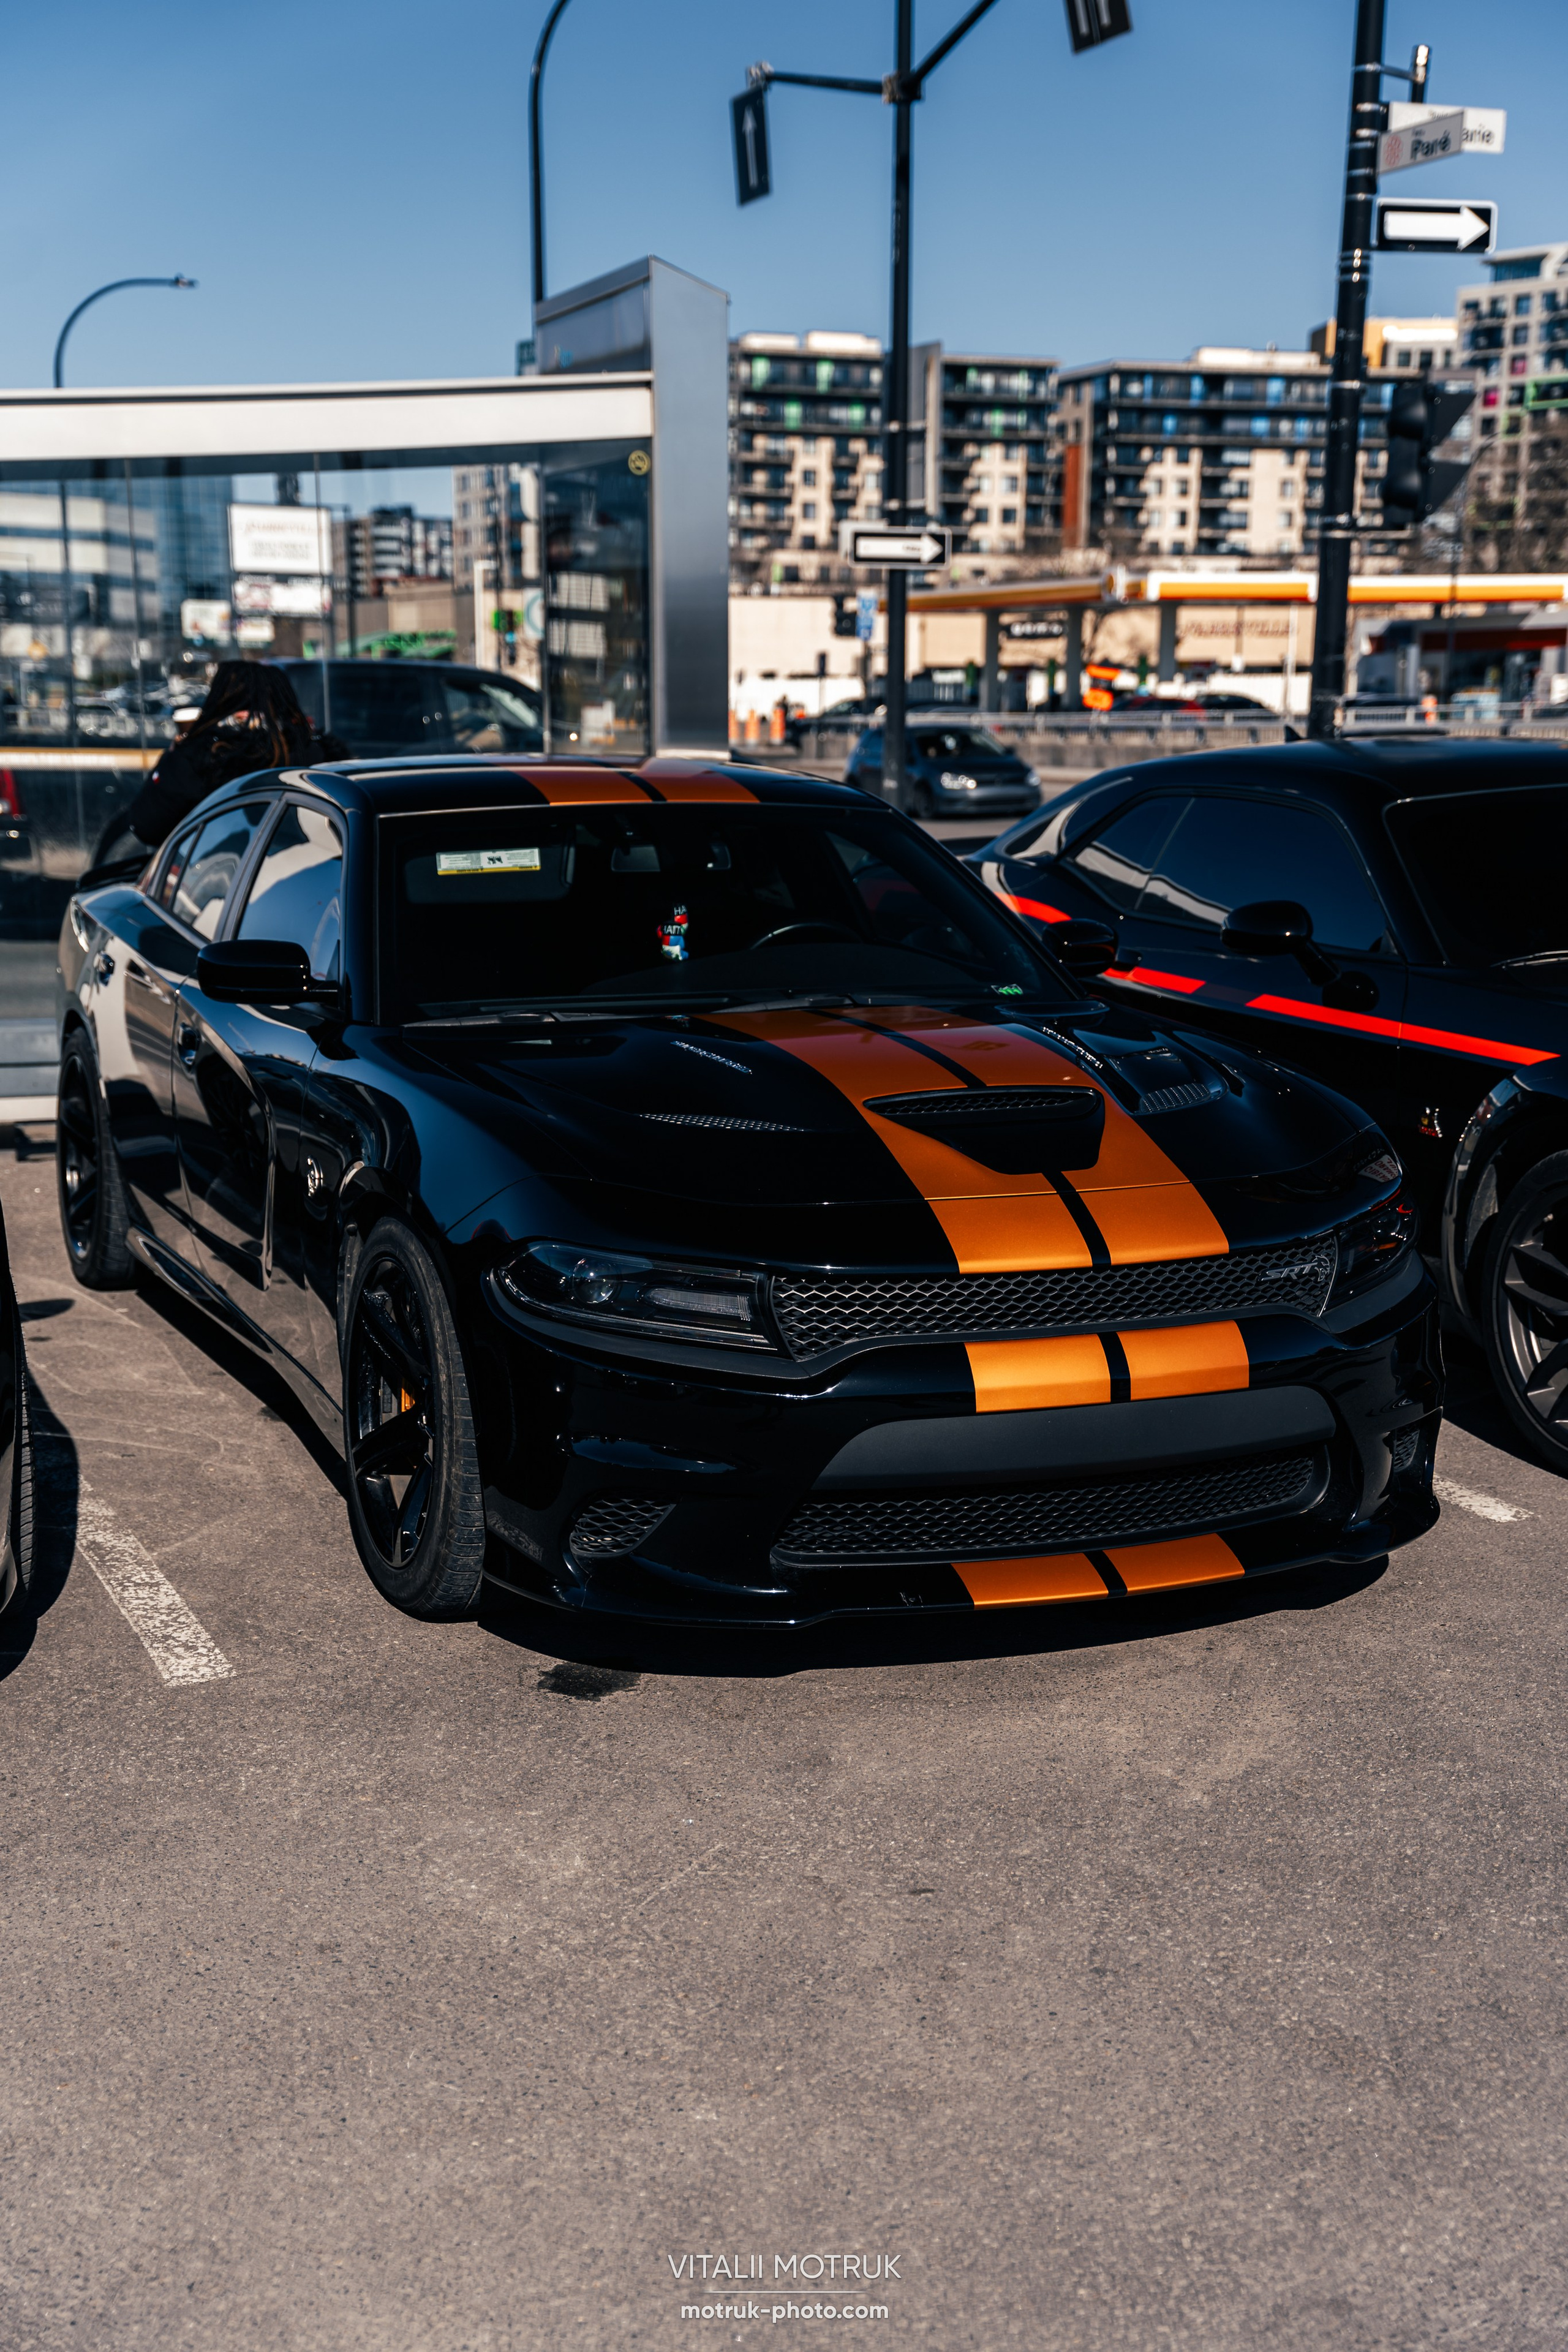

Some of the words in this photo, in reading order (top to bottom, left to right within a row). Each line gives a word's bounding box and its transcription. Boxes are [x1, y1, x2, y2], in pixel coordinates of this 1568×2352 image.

[1410, 129, 1451, 160] Paré
[1462, 124, 1494, 145] arie
[1261, 1262, 1317, 1281] SRT
